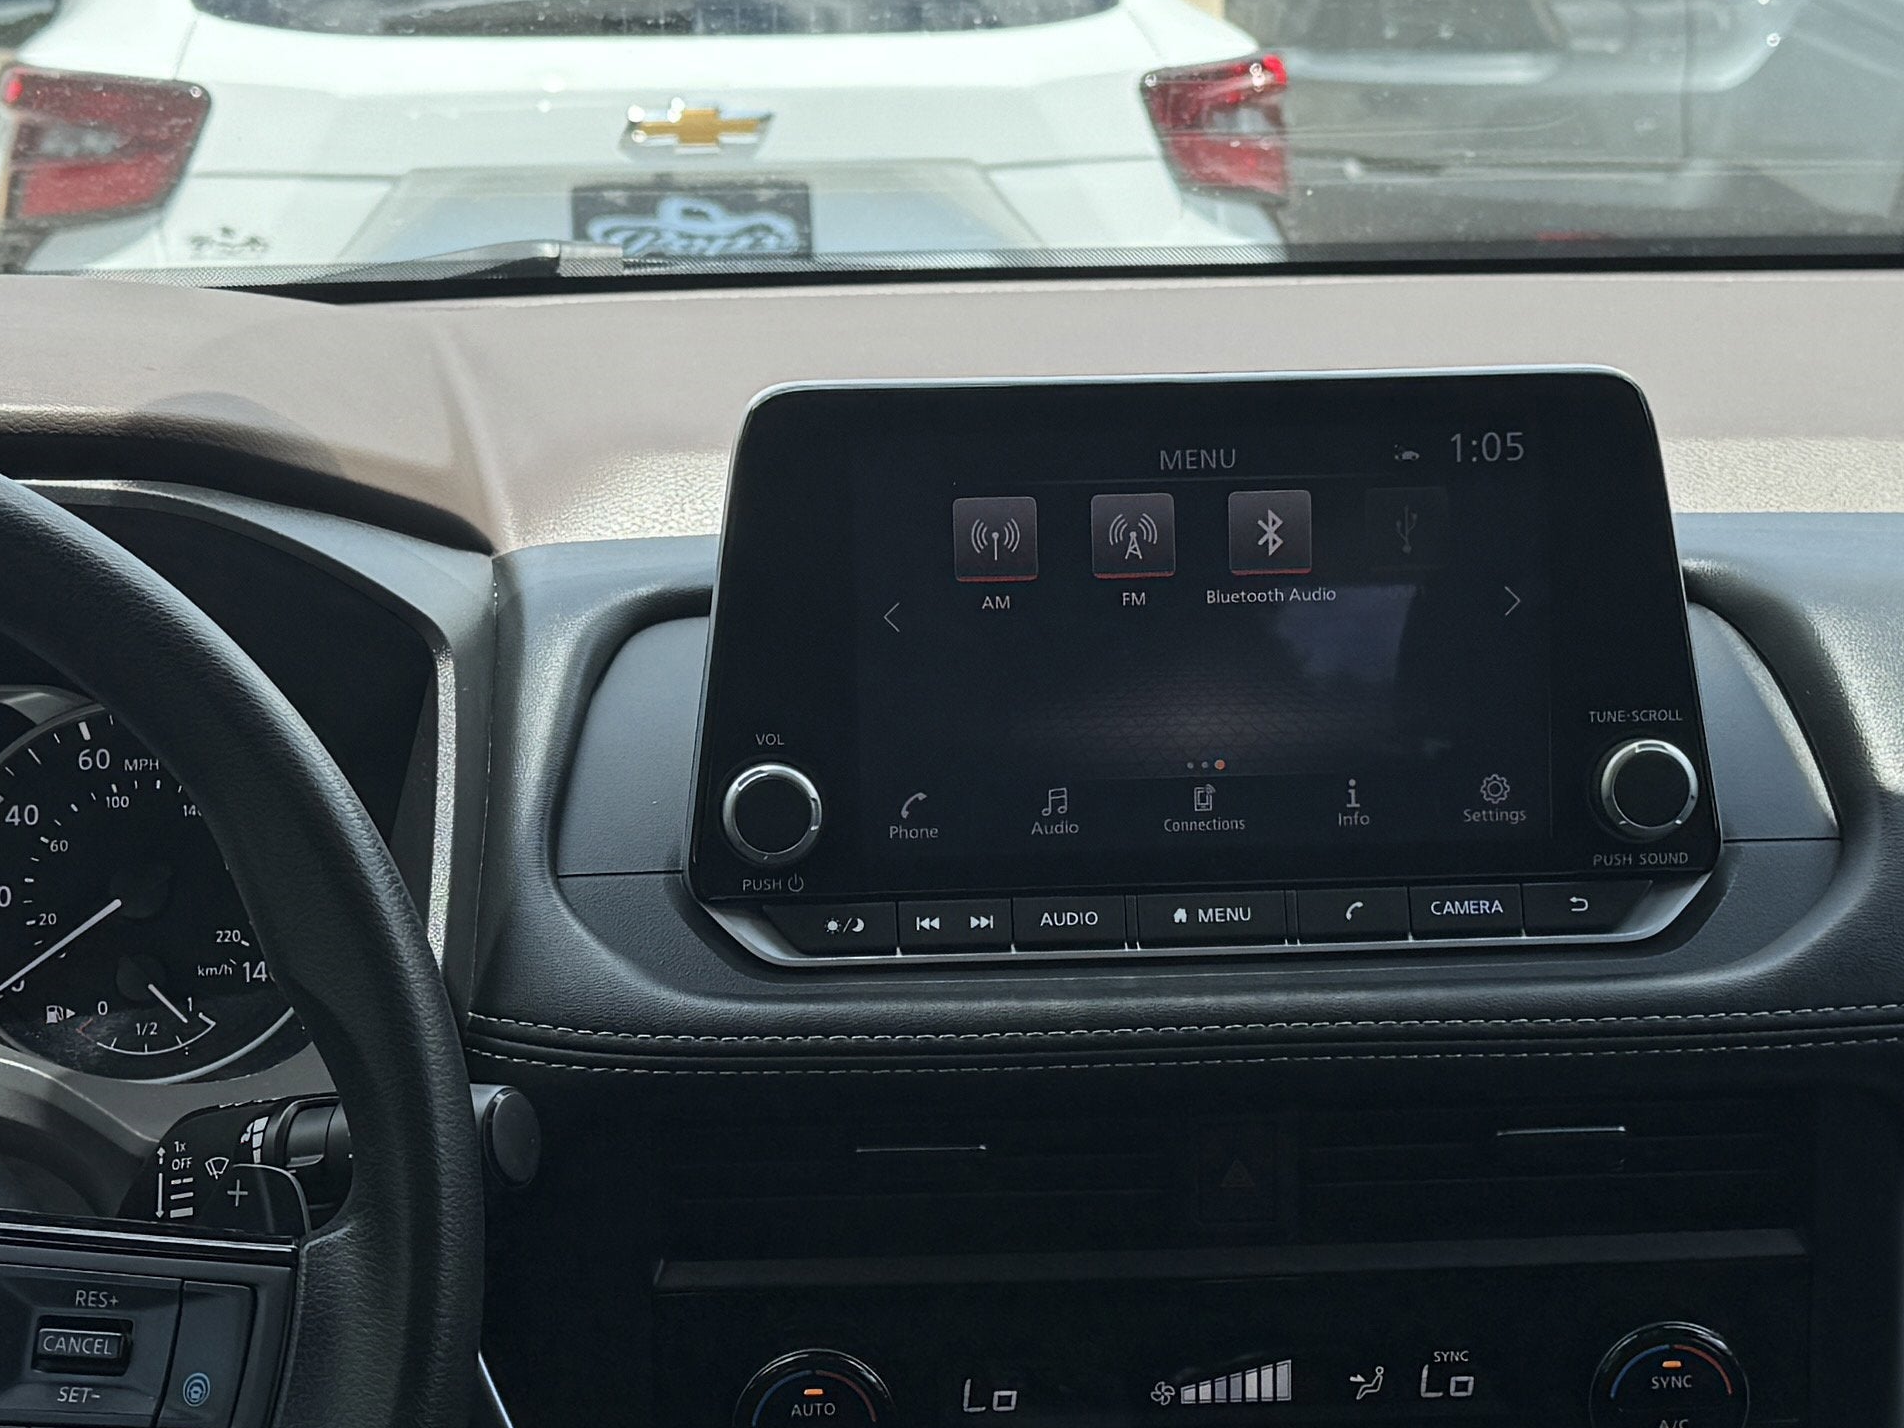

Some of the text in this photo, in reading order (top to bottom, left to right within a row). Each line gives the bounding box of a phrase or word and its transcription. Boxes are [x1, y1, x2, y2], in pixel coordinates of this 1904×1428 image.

[1449, 433, 1527, 463] 1:05
[1159, 447, 1238, 472] MENU
[980, 594, 1012, 612] AM
[1121, 590, 1148, 607] FM
[1205, 586, 1337, 606] Bluetooth Audio
[755, 733, 785, 746] VOL
[78, 748, 111, 771] 60
[123, 758, 160, 771] MPH
[105, 795, 130, 809] 100
[5, 803, 40, 827] 40
[183, 804, 202, 818] 14
[1337, 809, 1370, 827] Info
[1462, 805, 1528, 826] Settings
[888, 822, 940, 840] Phone
[1031, 818, 1080, 836] Audio
[1163, 815, 1246, 833] Connections
[50, 839, 69, 853] 60
[1592, 850, 1689, 867] PUSH SOUND
[742, 877, 784, 892] PUSH
[1198, 905, 1252, 924] MENU
[1430, 898, 1504, 917] CAMERA
[39, 912, 58, 926] 20
[1039, 909, 1099, 928] AUDIO
[215, 929, 241, 944] 220
[197, 962, 233, 977] km/h
[242, 960, 275, 984] 14
[97, 1001, 108, 1016] 0
[187, 997, 193, 1012] 1
[135, 1022, 158, 1036] 1/2
[173, 1141, 187, 1153] 1x
[171, 1157, 193, 1171] OFF
[75, 1289, 119, 1308] RES+
[43, 1335, 113, 1355] CANCEL
[1433, 1350, 1470, 1363] SYNC
[1651, 1374, 1693, 1390] SYNC
[790, 1402, 836, 1418] AUTO
